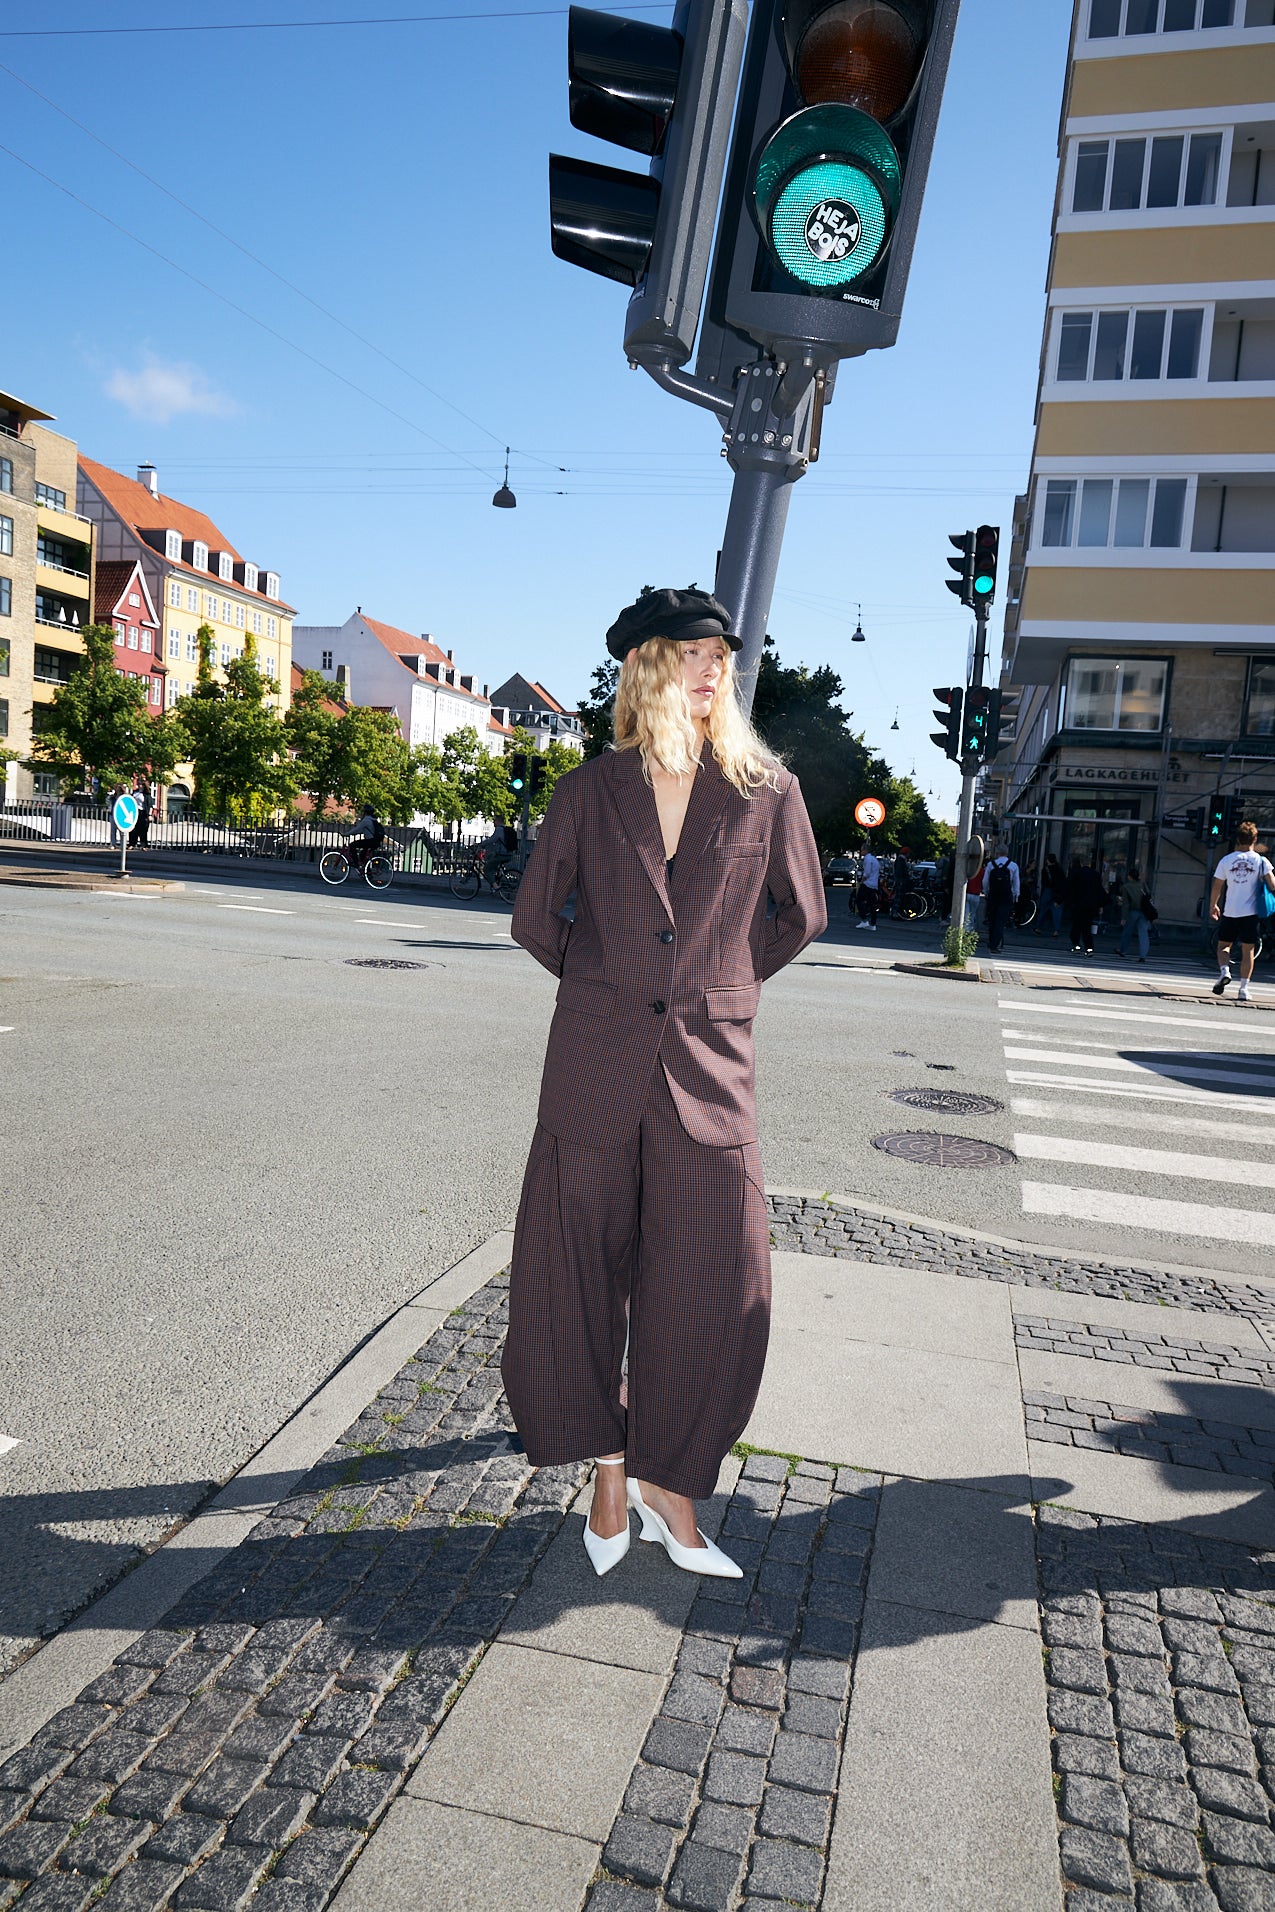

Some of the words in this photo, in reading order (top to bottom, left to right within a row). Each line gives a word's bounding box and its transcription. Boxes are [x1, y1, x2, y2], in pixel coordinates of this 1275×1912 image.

[816, 204, 859, 242] HEJA
[807, 220, 849, 257] BOIS
[842, 293, 871, 305] swarco
[975, 715, 983, 727] 4
